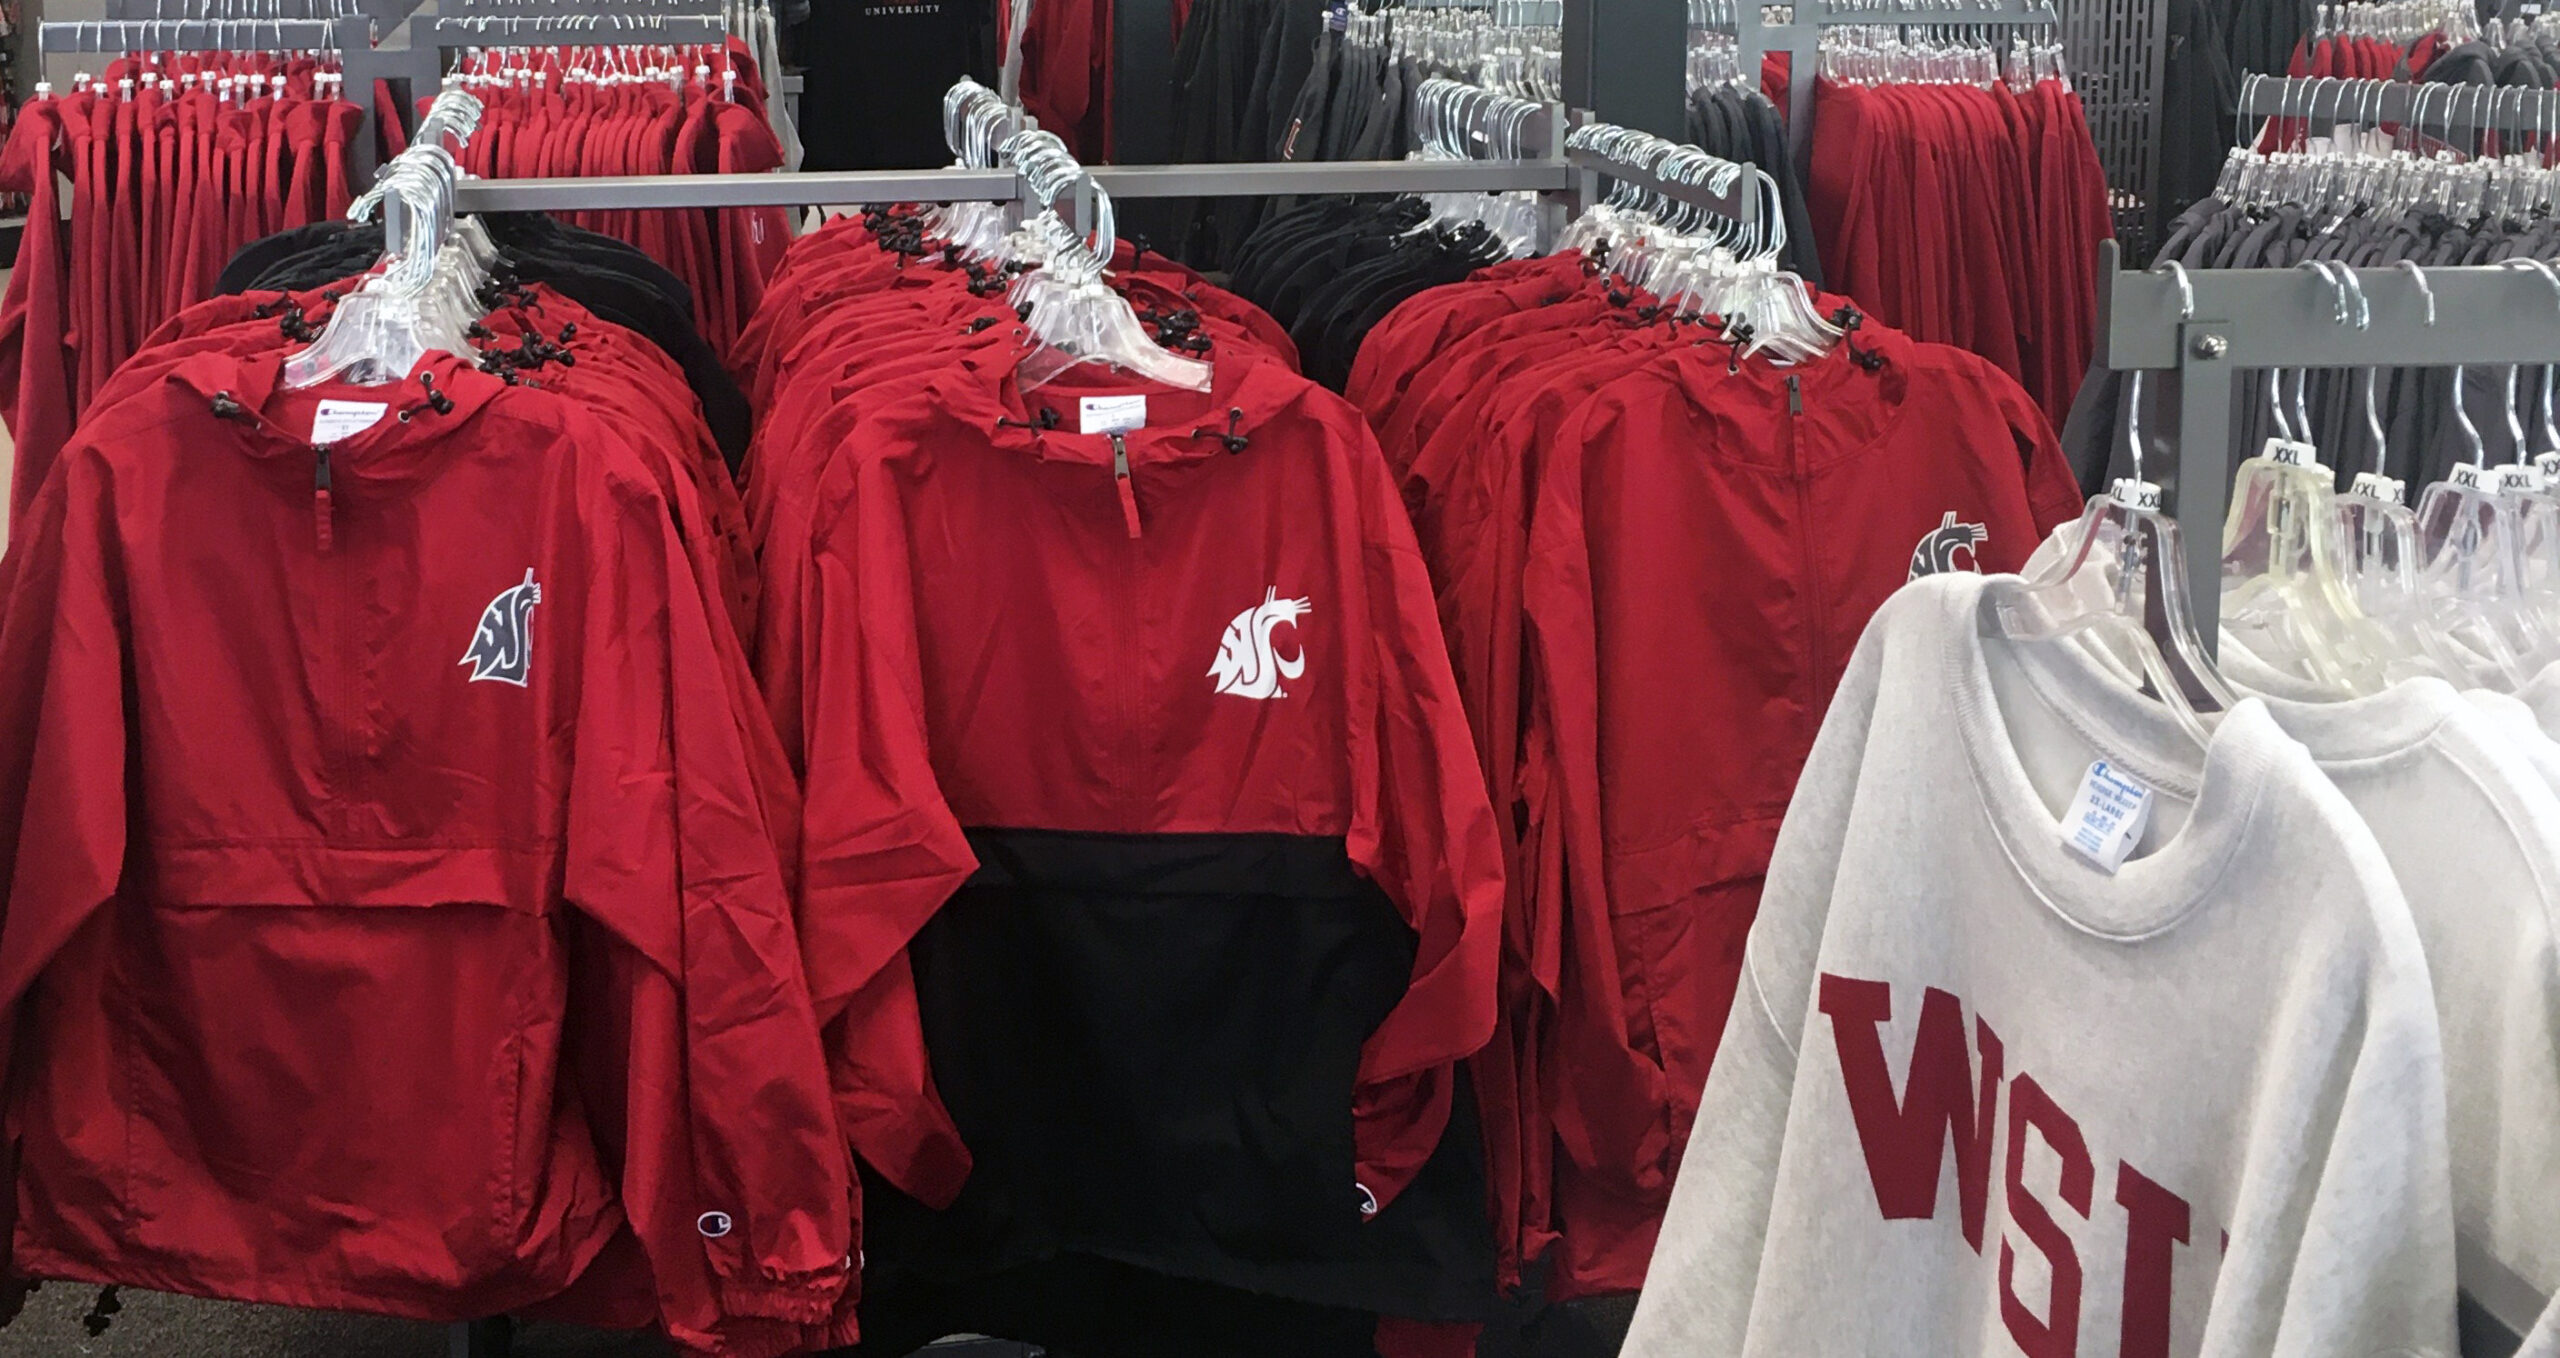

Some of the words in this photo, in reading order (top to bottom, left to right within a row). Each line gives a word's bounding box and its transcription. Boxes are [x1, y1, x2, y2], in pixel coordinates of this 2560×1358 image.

[864, 5, 940, 16] UNIVERSITY
[2272, 446, 2301, 466] XXL
[2455, 469, 2480, 489] XXL
[2503, 473, 2532, 488] XXL
[2092, 762, 2143, 799] Champion
